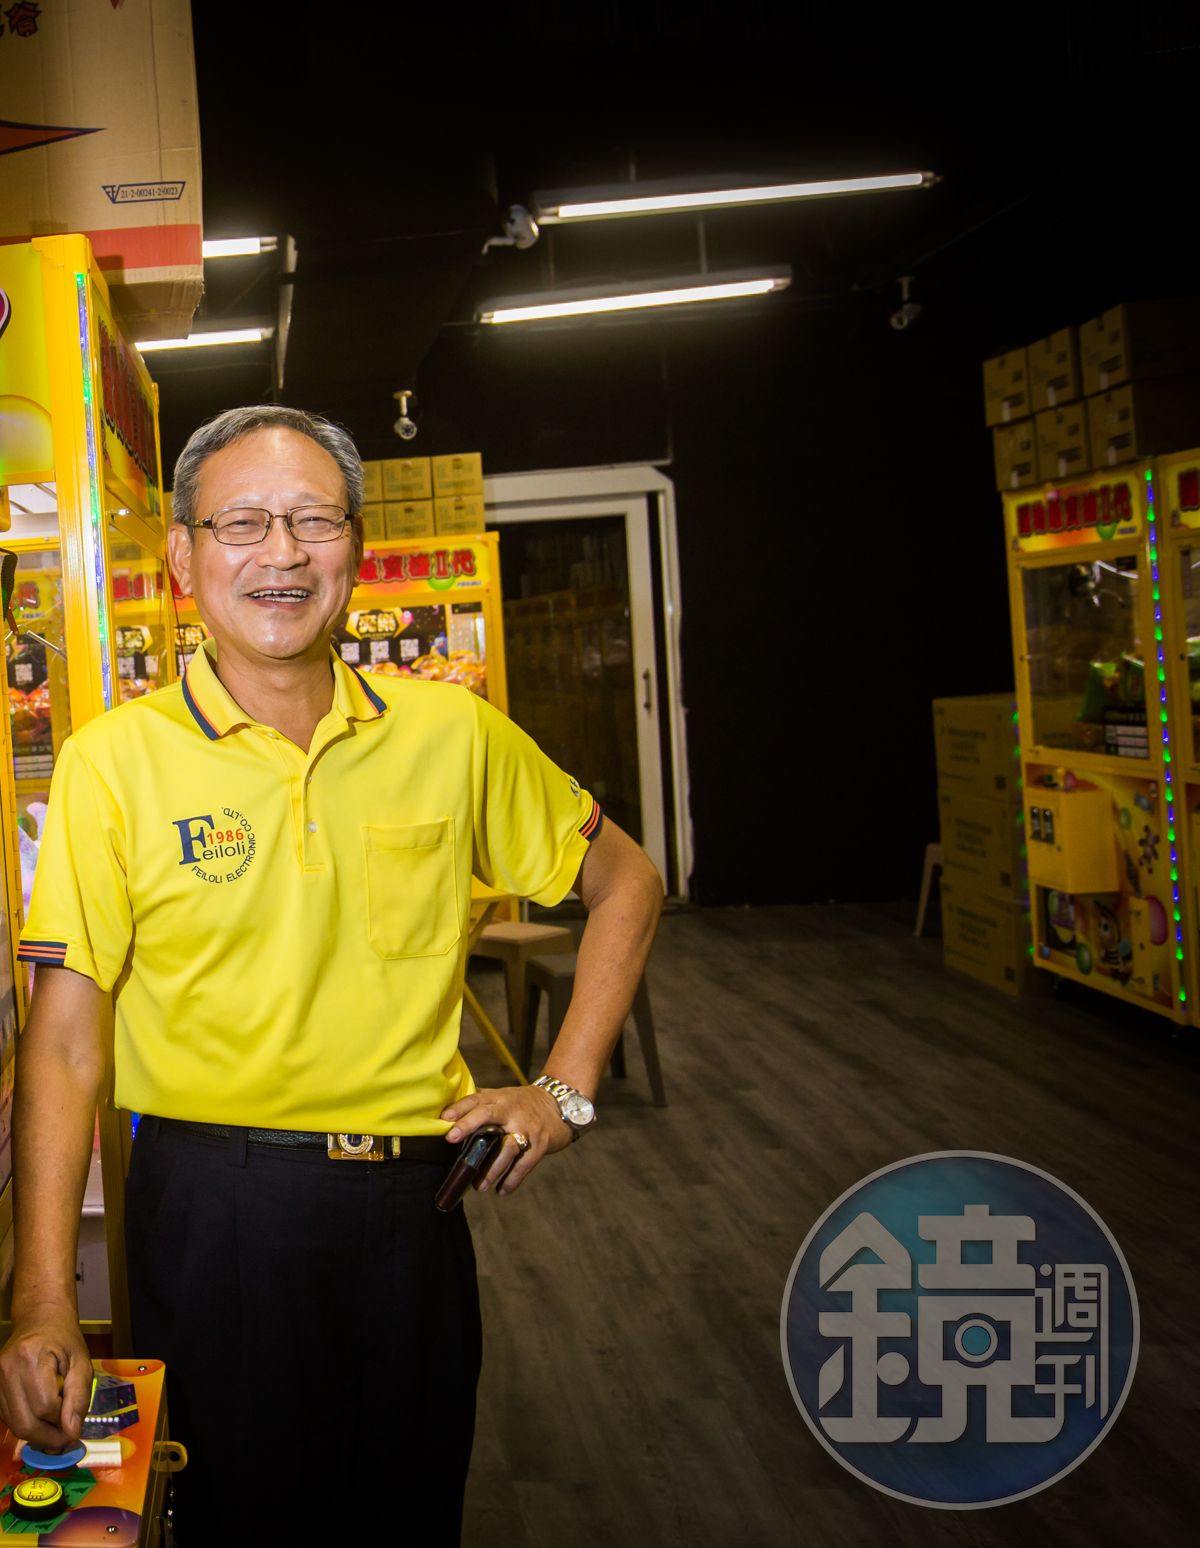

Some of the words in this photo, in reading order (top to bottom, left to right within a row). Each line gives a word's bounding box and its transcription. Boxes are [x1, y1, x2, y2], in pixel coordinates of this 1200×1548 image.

[172, 815, 246, 865] Feiloli
[191, 865, 223, 883] FEILOLI
[226, 833, 256, 882] ELECTRONIC
[207, 828, 244, 845] 1986
